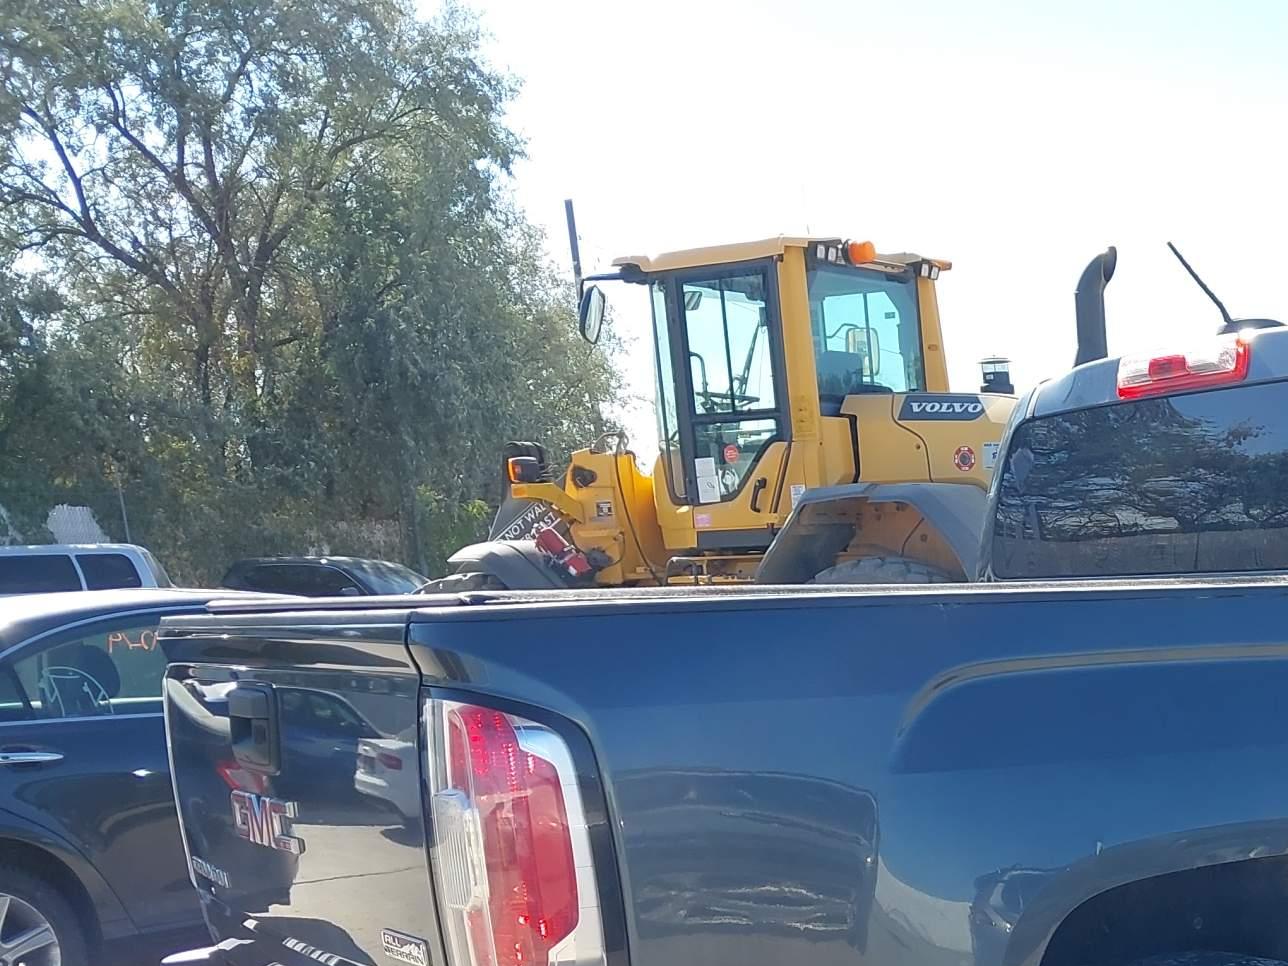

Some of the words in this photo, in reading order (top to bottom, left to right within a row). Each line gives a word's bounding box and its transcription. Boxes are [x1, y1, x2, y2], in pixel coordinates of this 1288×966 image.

[909, 401, 983, 414] VOLVO
[524, 500, 548, 523] WAL
[231, 789, 305, 855] GMC
[384, 934, 402, 947] ALL
[384, 945, 425, 965] TERRAIN
